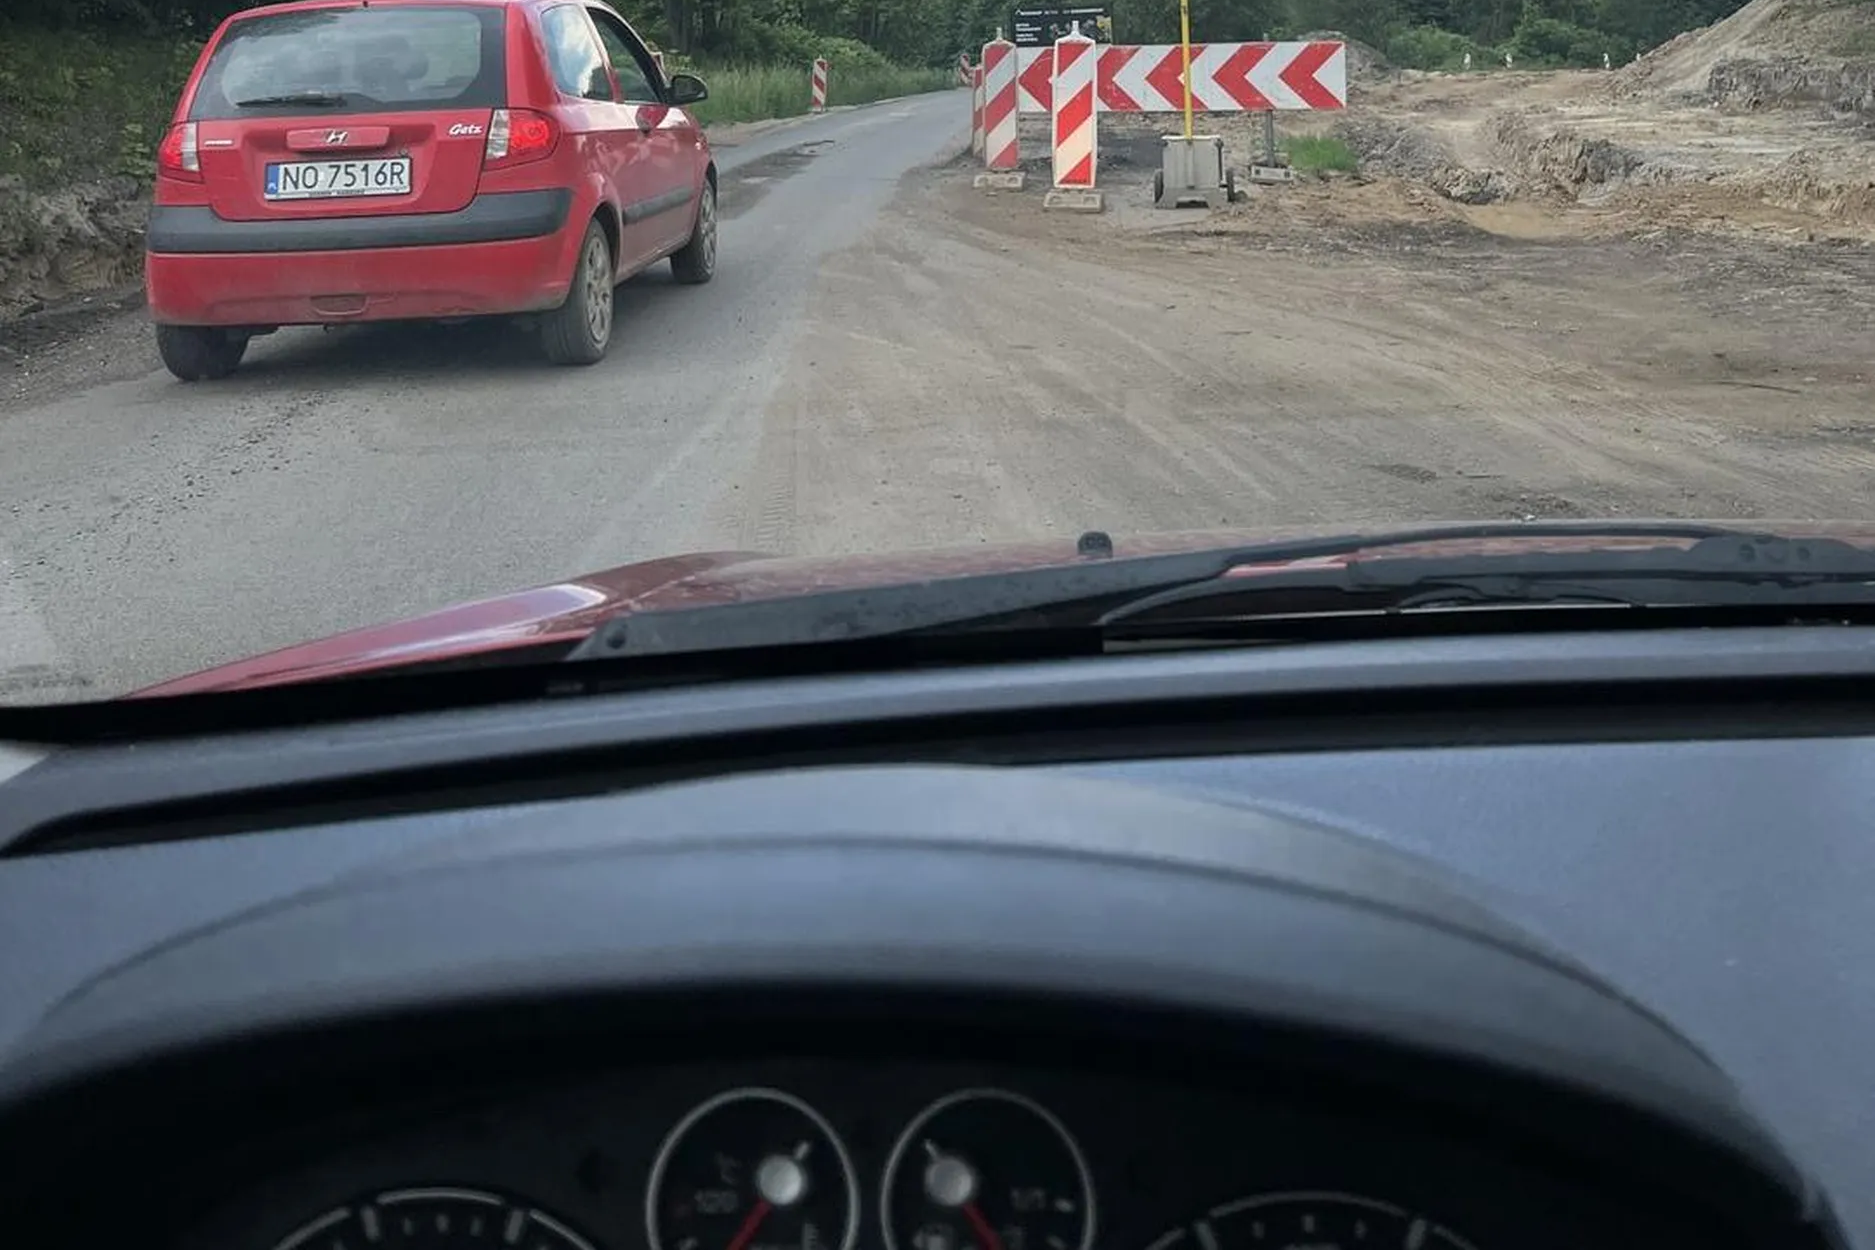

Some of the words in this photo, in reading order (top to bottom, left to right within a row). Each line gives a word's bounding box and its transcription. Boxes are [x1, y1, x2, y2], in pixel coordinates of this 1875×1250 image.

[449, 123, 482, 135] Getz
[282, 165, 319, 190] NO
[328, 162, 405, 188] 7516R
